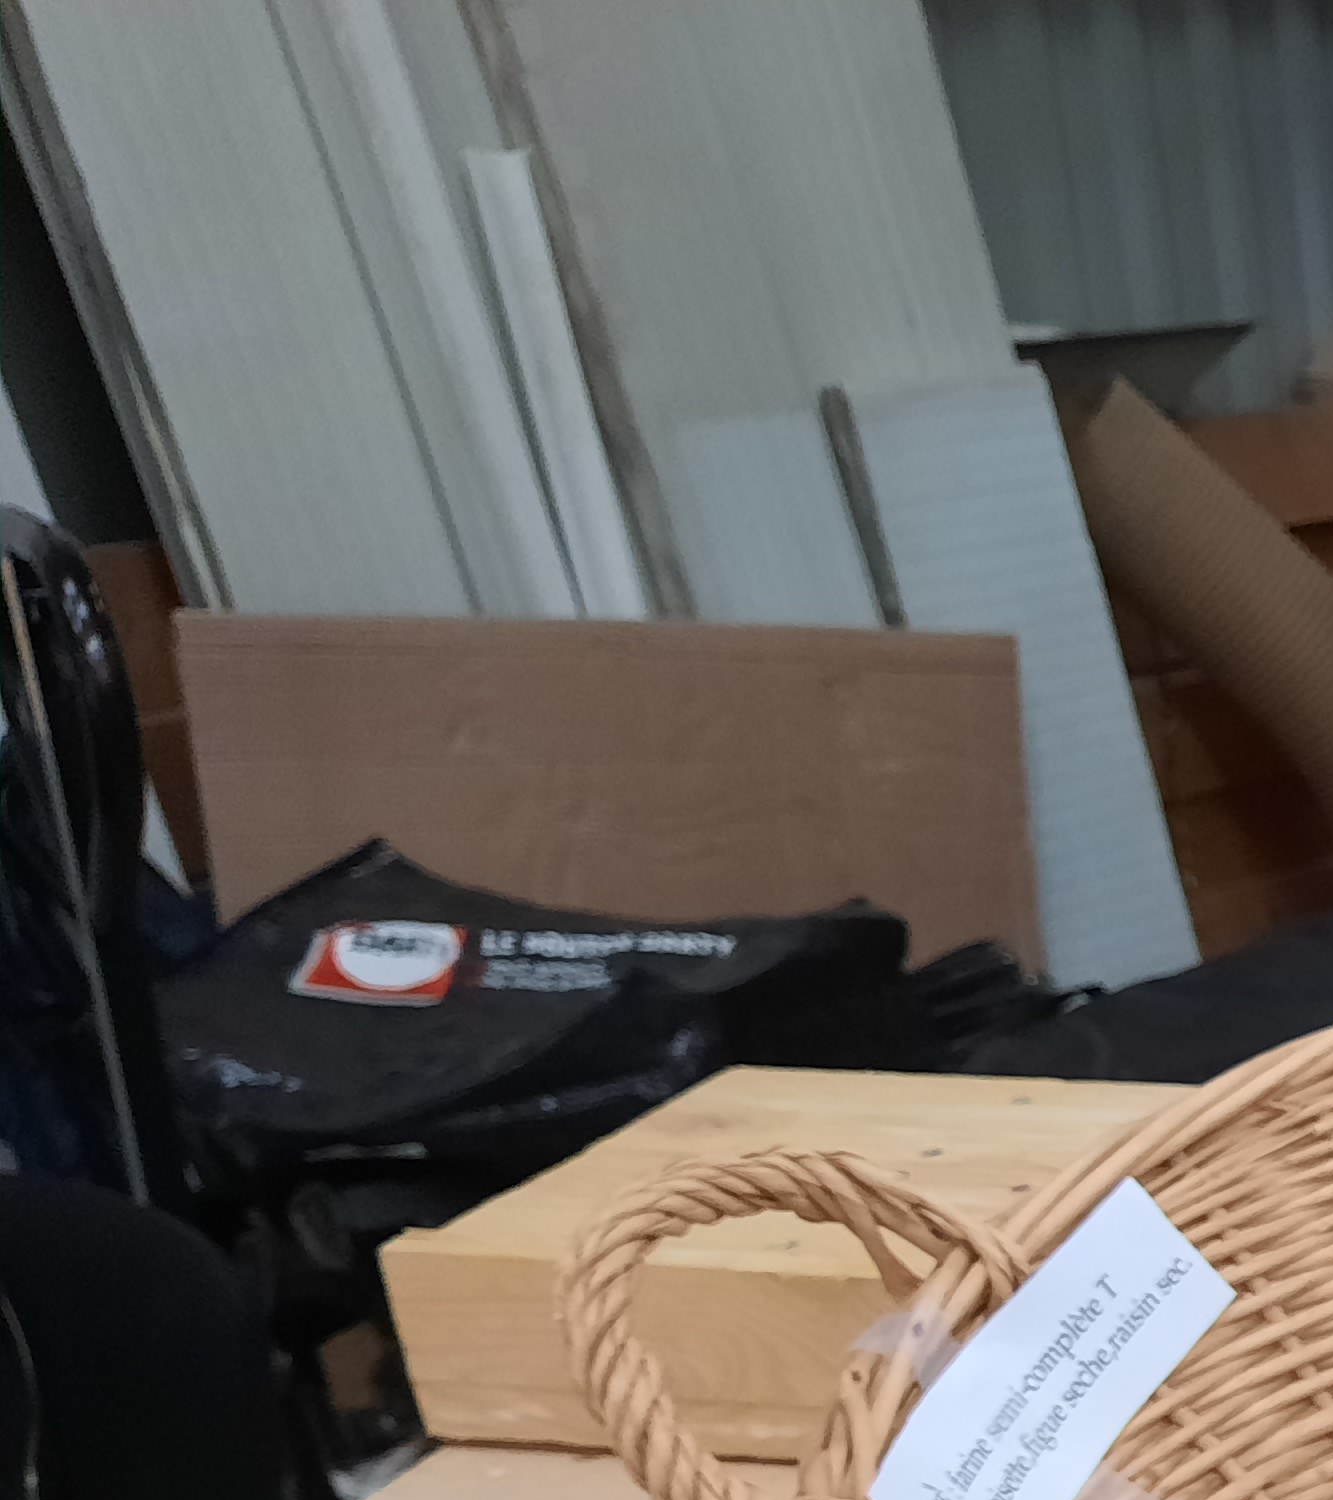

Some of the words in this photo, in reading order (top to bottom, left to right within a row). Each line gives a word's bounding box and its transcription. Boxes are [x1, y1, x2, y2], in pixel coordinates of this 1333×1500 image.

[945, 1438, 993, 1492] farine
[986, 1298, 1104, 1438] semi-complète
[1095, 1273, 1117, 1298] T
